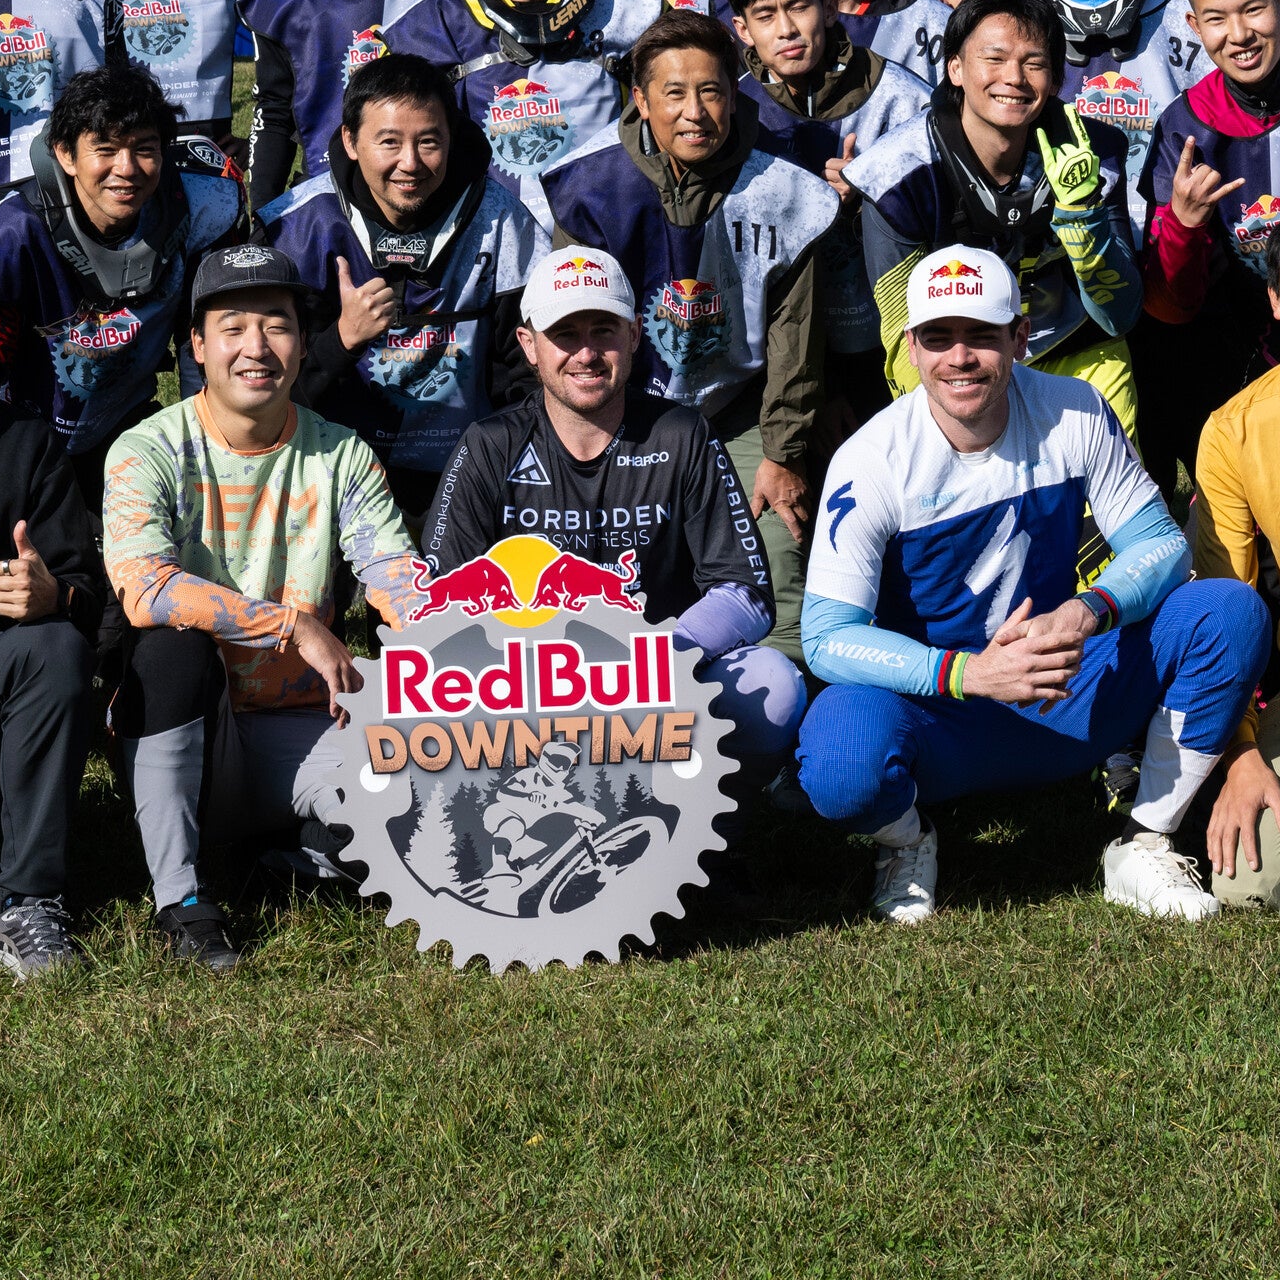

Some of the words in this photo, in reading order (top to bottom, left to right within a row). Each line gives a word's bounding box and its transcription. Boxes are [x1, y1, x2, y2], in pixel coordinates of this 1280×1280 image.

[123, 1, 152, 18] Red
[13, 30, 48, 52] Bull
[914, 26, 944, 66] 90
[1168, 36, 1203, 72] 37
[350, 48, 379, 64] Red
[489, 102, 525, 124] Red
[524, 97, 562, 118] Bull
[1075, 97, 1111, 116] Red
[1112, 96, 1150, 117] Bull
[489, 115, 567, 138] DOWNTIME
[731, 220, 777, 260] 111
[1235, 225, 1272, 243] Red
[553, 278, 581, 292] Red
[583, 275, 610, 290] Bull
[927, 284, 954, 300] Red
[955, 281, 983, 297] Bull
[662, 287, 689, 320] Red
[689, 293, 722, 319] Bull
[69, 326, 103, 348] Red
[103, 321, 141, 347] Bull
[387, 331, 424, 349] Red
[424, 323, 457, 349] Bull
[375, 428, 461, 439] DEFENDER
[193, 482, 317, 532] TEAM
[503, 502, 671, 531] FORBIDDEN
[706, 438, 769, 587] FORBIDDEN
[552, 530, 651, 551] SYNTHESIS
[381, 638, 526, 718] Red
[534, 631, 675, 712] Bull
[364, 711, 696, 776] DOWNTIME
